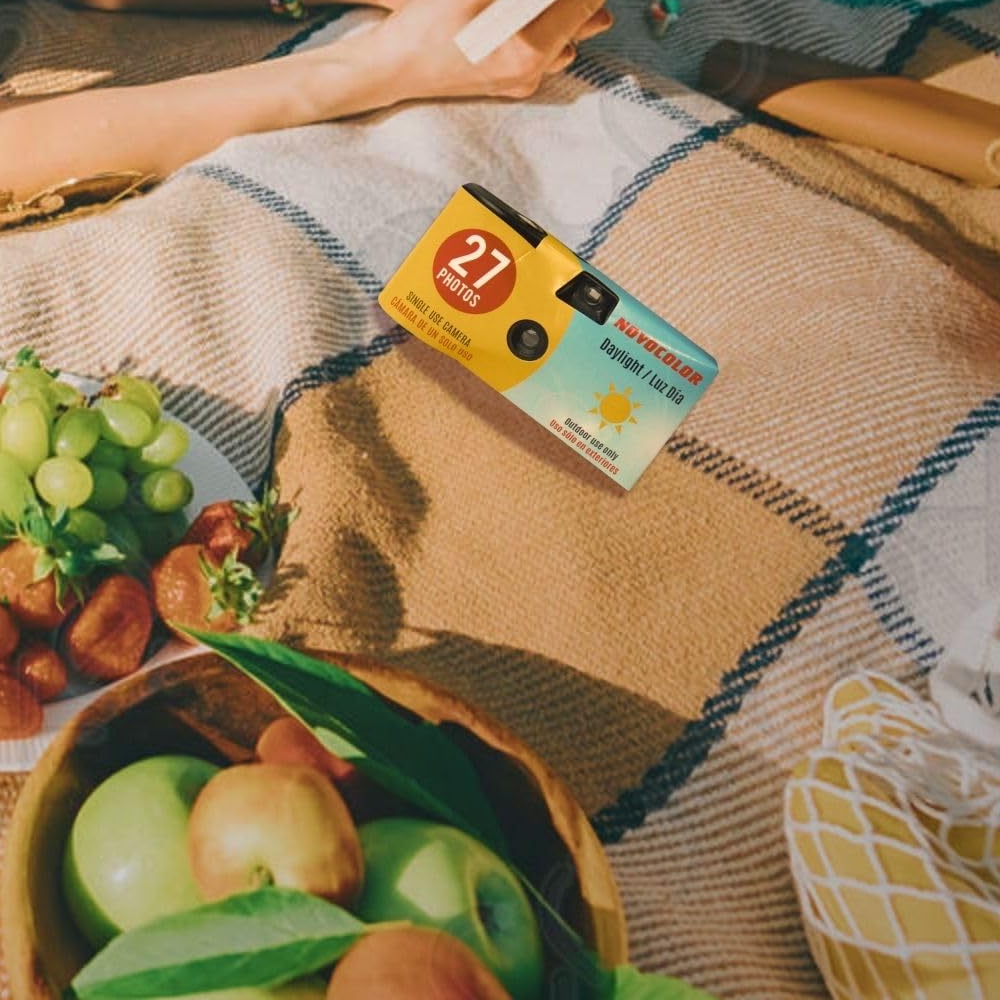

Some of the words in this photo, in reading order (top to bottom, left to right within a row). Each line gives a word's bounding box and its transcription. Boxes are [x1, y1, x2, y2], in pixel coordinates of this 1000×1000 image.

[436, 267, 481, 307] PHOTOS
[448, 234, 511, 290] 27
[406, 291, 430, 315] SINGLE
[428, 310, 444, 326] USE
[442, 321, 472, 348] CAMERA
[416, 318, 428, 331] DE
[426, 326, 439, 340] UN
[438, 335, 457, 352] SOLO
[457, 347, 473, 361] USO
[600, 338, 645, 376] Daylight
[648, 374, 669, 394] Luz
[665, 385, 685, 405] Día
[614, 317, 704, 386] NOVOCOLOR
[549, 419, 563, 433] Uso
[561, 429, 578, 444] sólo
[576, 441, 586, 451] en
[585, 447, 620, 475] exteriores
[564, 417, 592, 441] Outdoor
[589, 437, 604, 450] use
[602, 446, 620, 461] only
